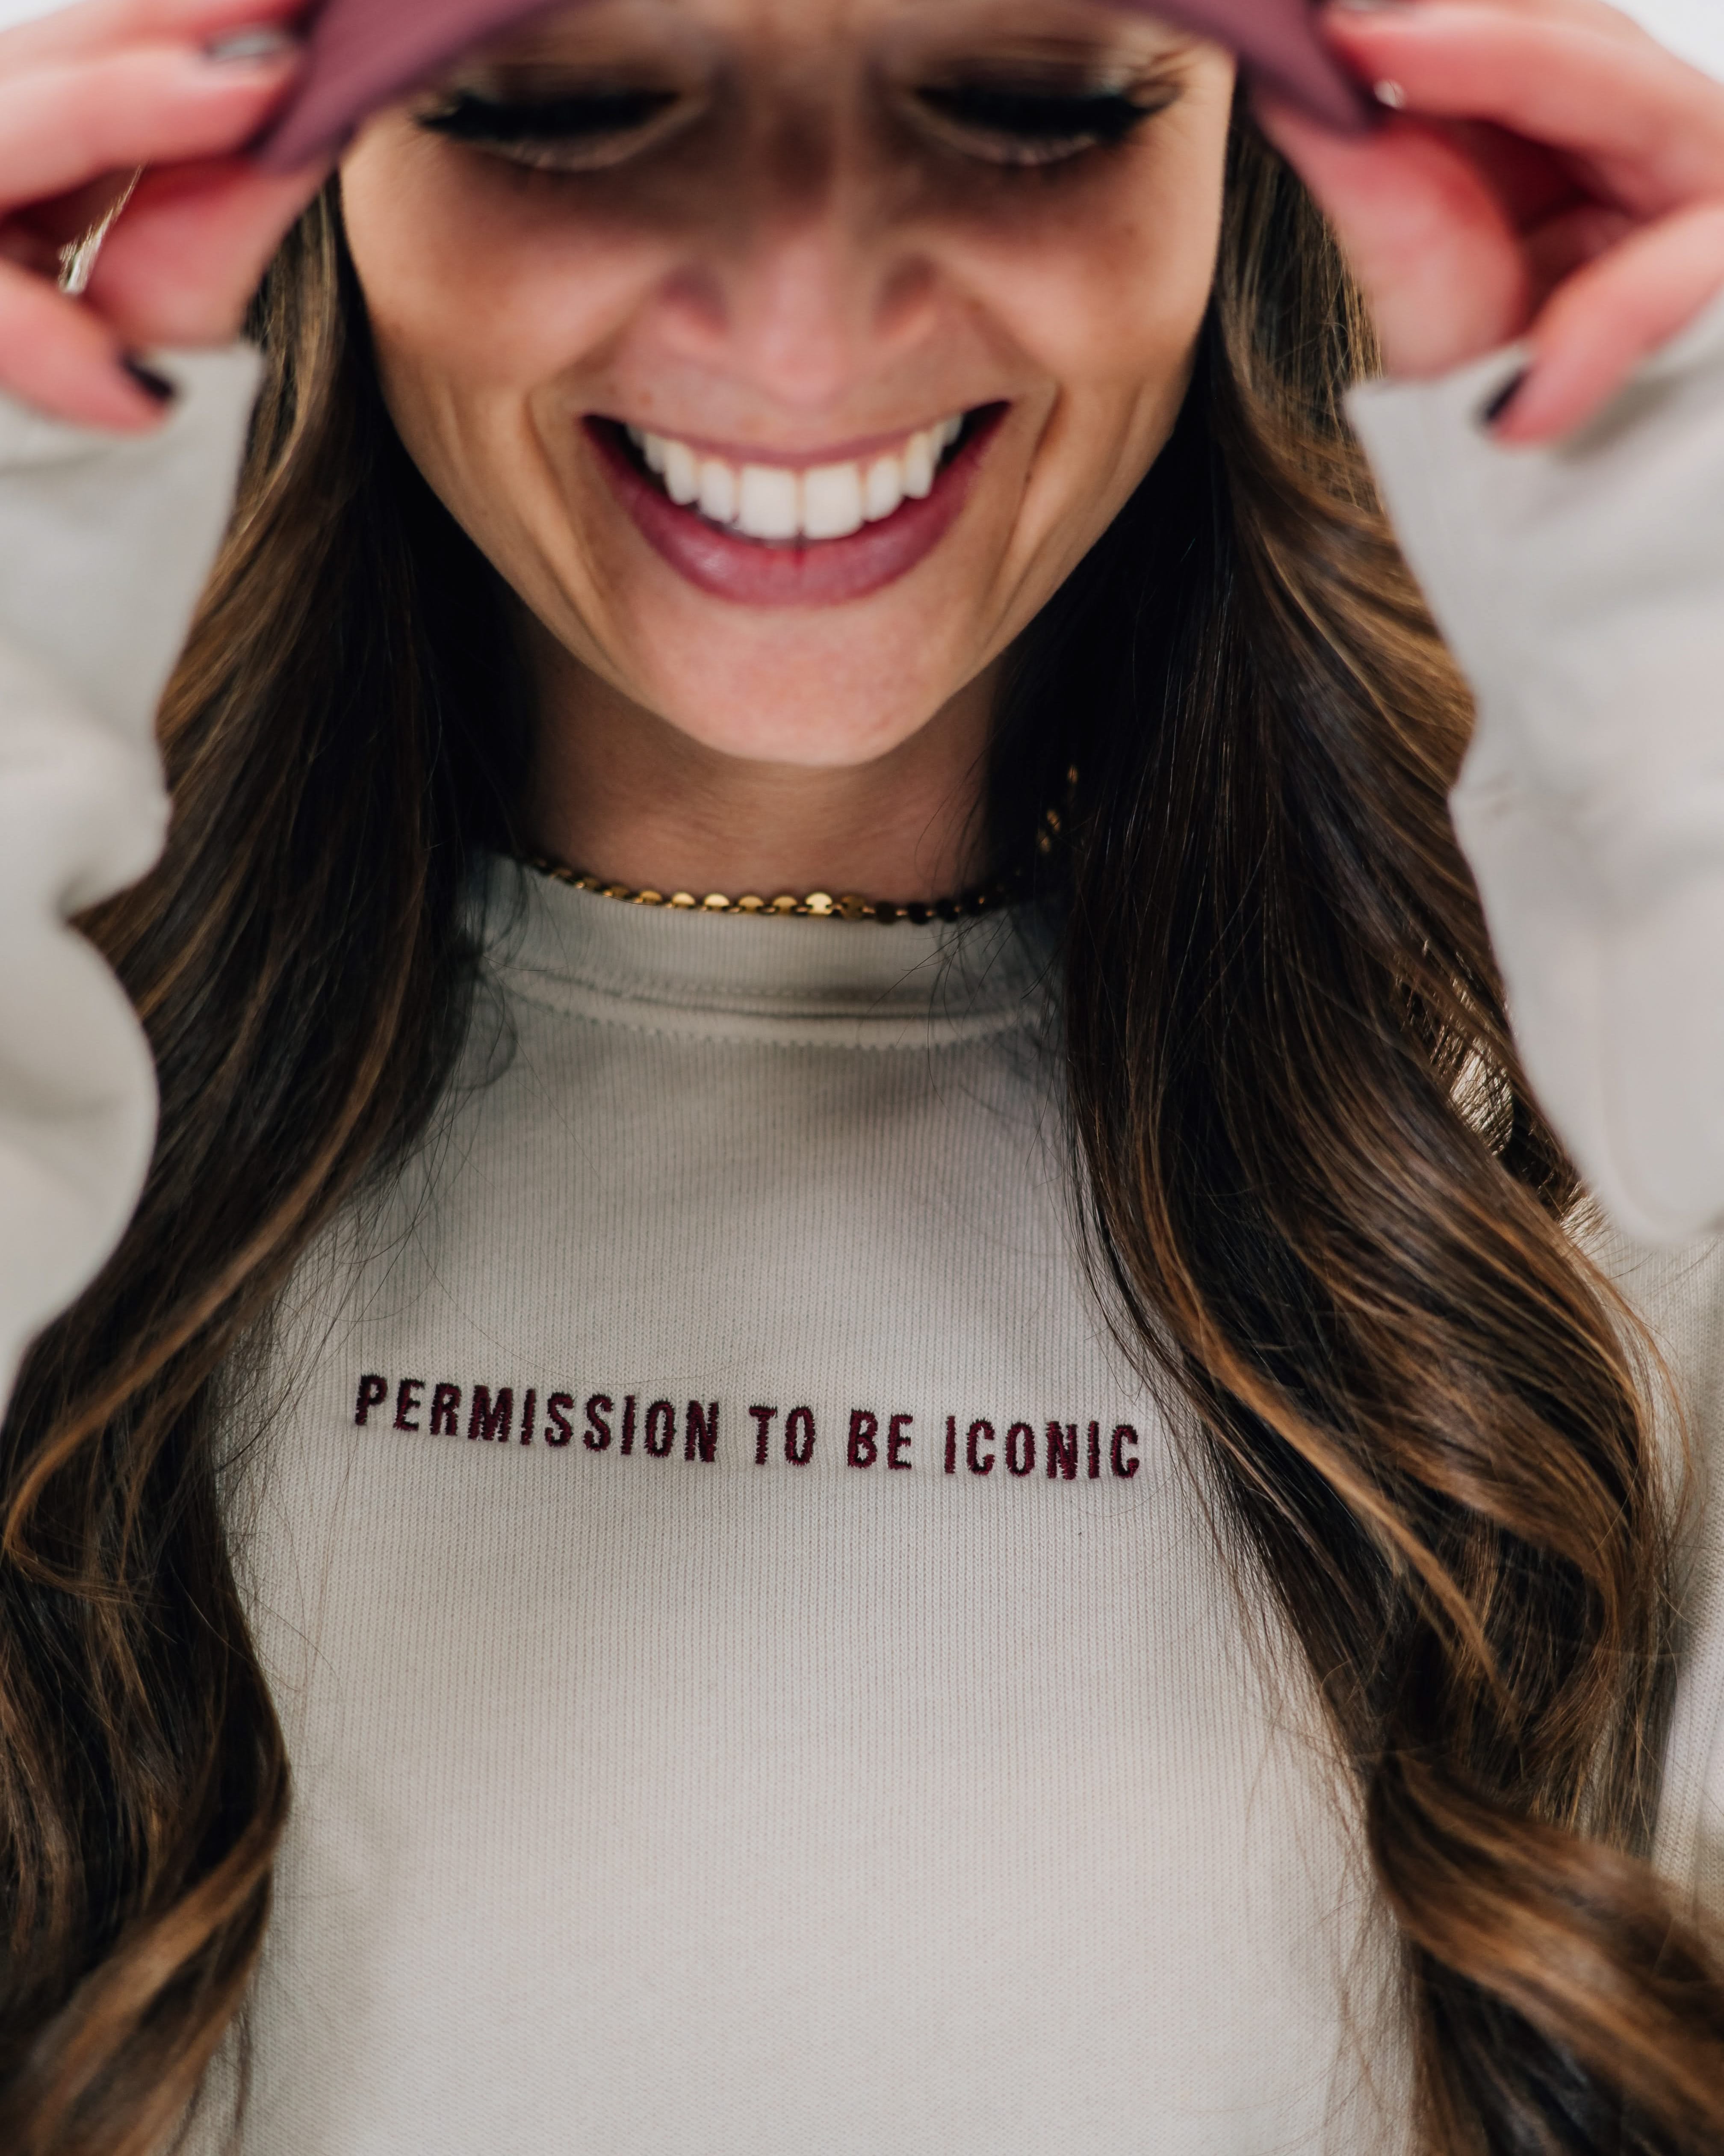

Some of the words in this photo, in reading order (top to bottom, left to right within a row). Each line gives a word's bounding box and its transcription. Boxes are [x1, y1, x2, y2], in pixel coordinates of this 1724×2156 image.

[354, 1372, 720, 1464] PERMISSION
[748, 1403, 816, 1467] TO
[846, 1408, 913, 1471] BE
[943, 1416, 1140, 1480] ICONIC
